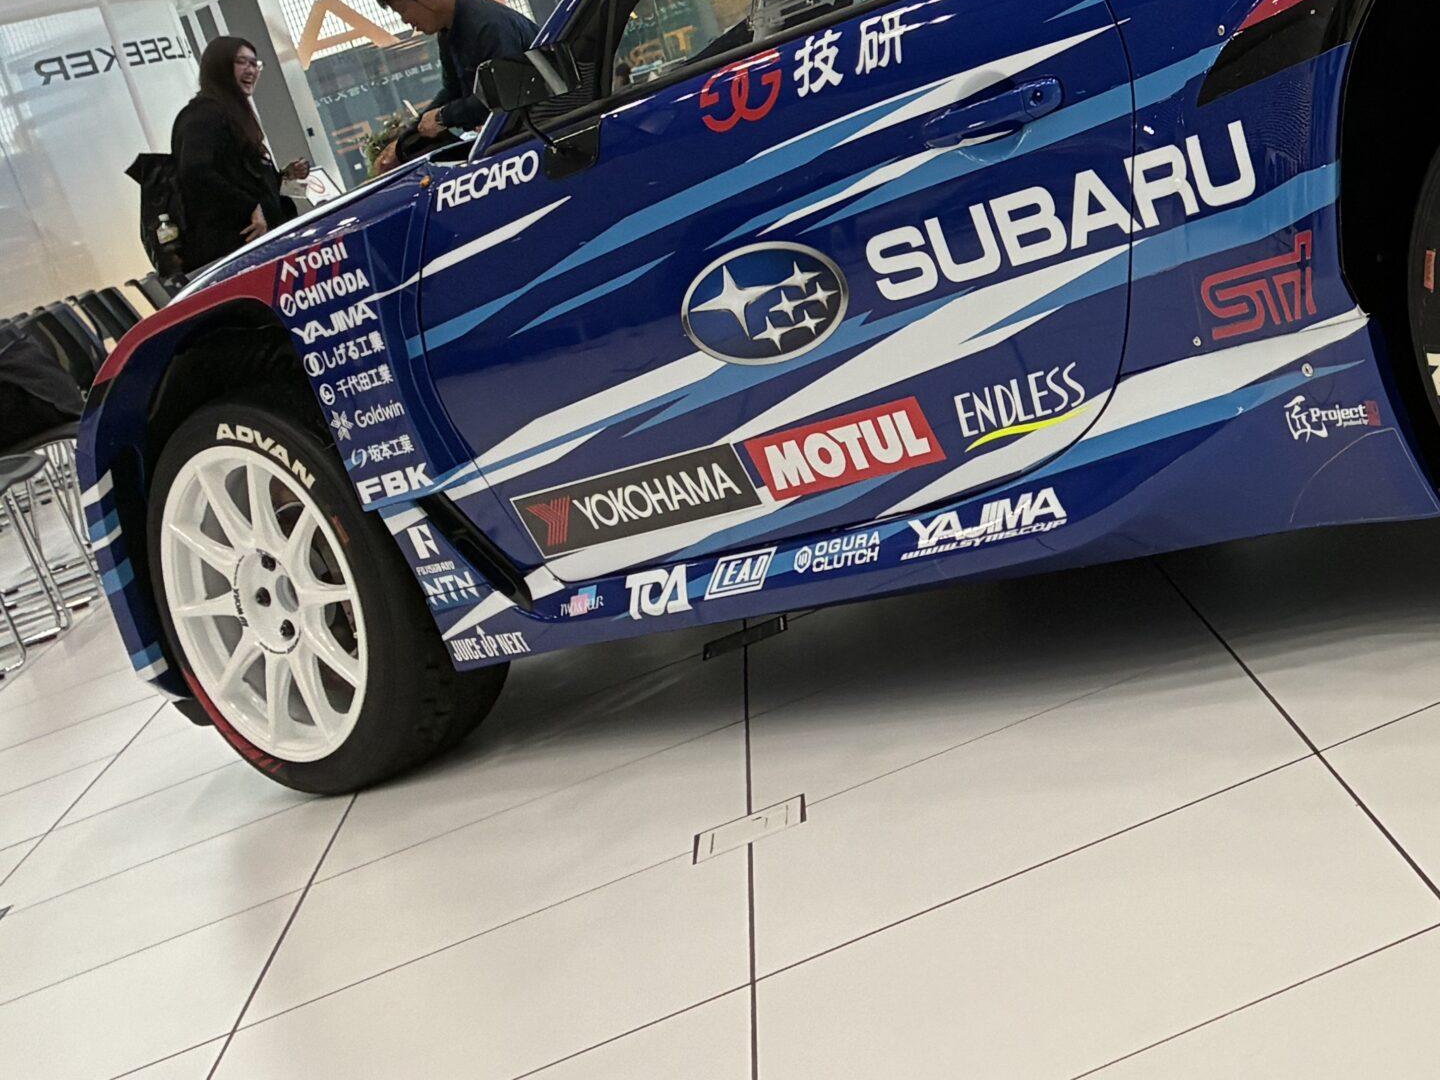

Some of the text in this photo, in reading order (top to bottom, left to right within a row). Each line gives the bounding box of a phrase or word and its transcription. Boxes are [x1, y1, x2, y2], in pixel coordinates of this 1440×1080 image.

[435, 150, 539, 213] RECARO
[865, 122, 1256, 302] SUBARU
[295, 241, 349, 274] TORII
[294, 268, 370, 310] CHIYODA
[291, 301, 378, 345] YAJIMA
[322, 330, 386, 369] しげる工業
[336, 363, 394, 398] 千代田工業
[954, 361, 1085, 438] ENDLESS
[354, 399, 405, 428] Goldwin
[1310, 404, 1368, 428] Project
[216, 423, 316, 489] ADVAN
[764, 409, 932, 493] MOTUL
[356, 462, 434, 505] FBK
[573, 462, 742, 529] YOKOHAMA
[909, 487, 1067, 550] YAJIMA
[812, 546, 879, 572] CLUTCH
[815, 531, 880, 557] OGURA
[422, 572, 480, 606] NTN
[709, 553, 767, 594] LEAD
[450, 630, 532, 662] JUICE UP NEXT
